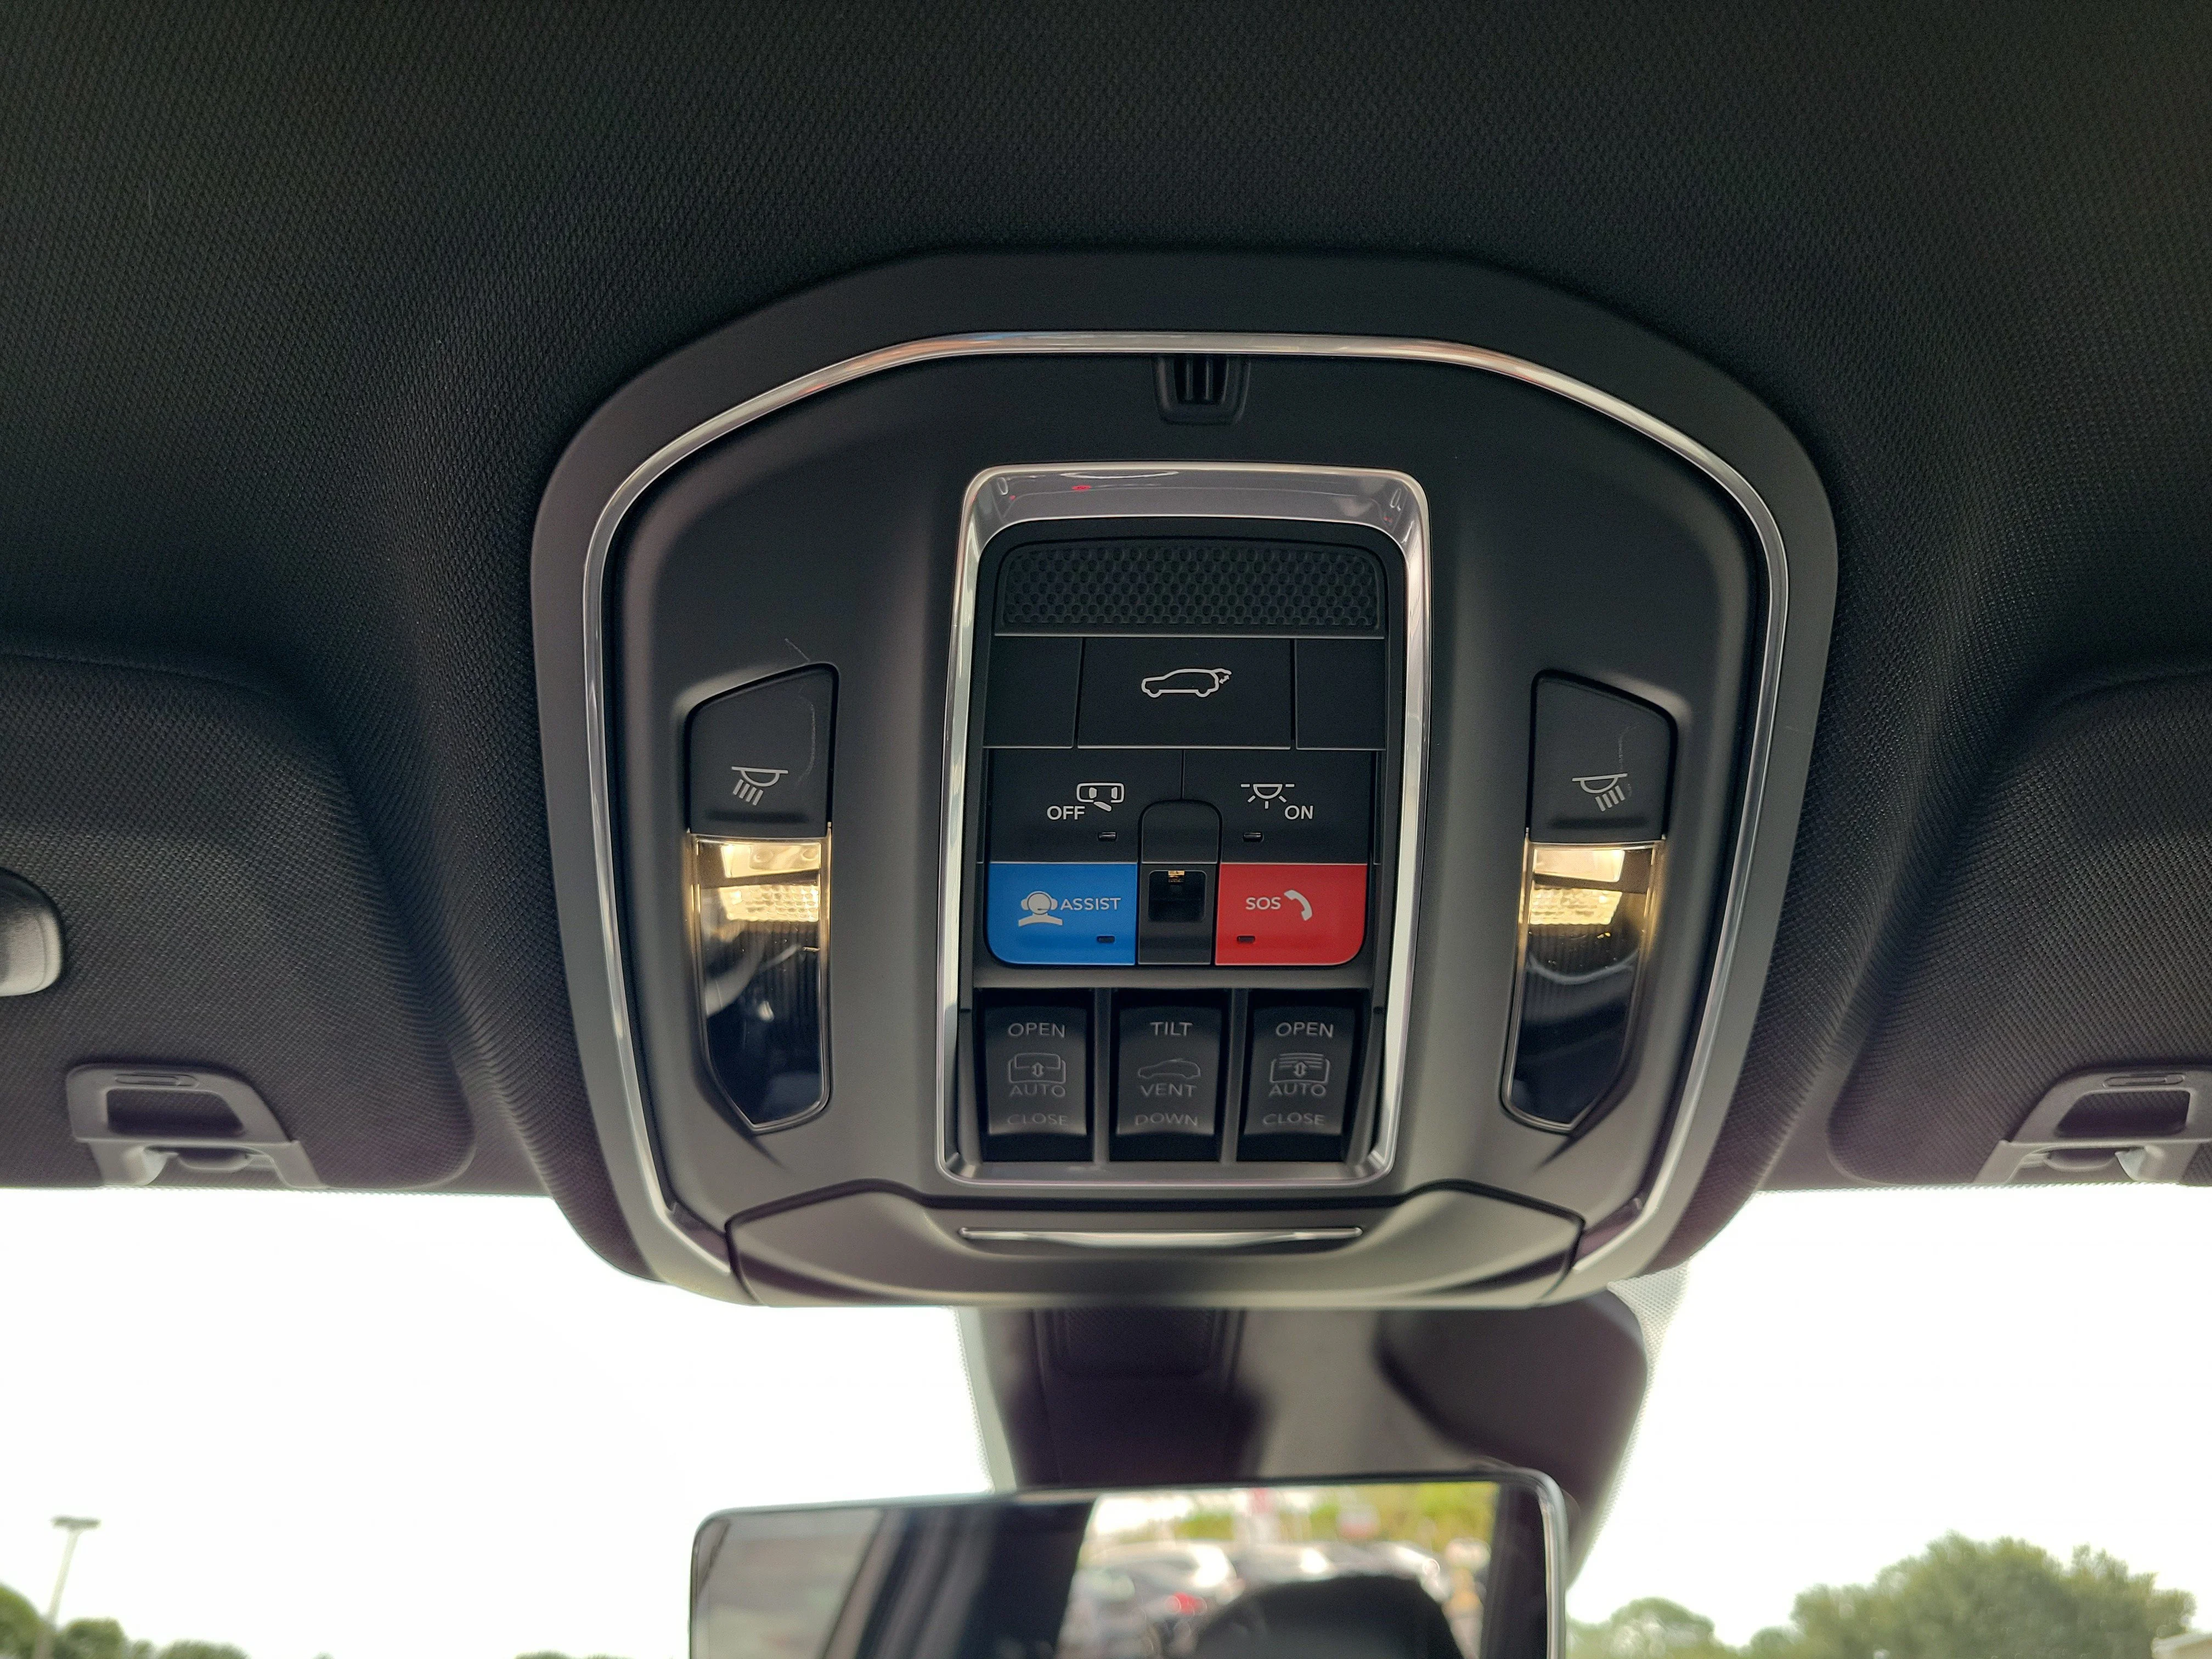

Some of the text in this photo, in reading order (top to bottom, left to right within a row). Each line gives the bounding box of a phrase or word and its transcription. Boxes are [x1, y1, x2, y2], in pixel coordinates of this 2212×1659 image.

[1047, 805, 1085, 820] OFF
[1284, 805, 1314, 820] ON
[1060, 898, 1121, 911] ASSIST
[1245, 897, 1281, 910] SOS
[1008, 1022, 1066, 1038] OPEN
[1150, 1022, 1193, 1037] TILT
[1275, 1022, 1334, 1038] OPEN
[1009, 1084, 1066, 1097] AUTO
[1139, 1084, 1197, 1097] VENT
[1268, 1084, 1327, 1097] AUTO
[1007, 1114, 1068, 1126] CLOSE
[1135, 1113, 1198, 1126] DOWN
[1263, 1113, 1325, 1126] CLOSE
